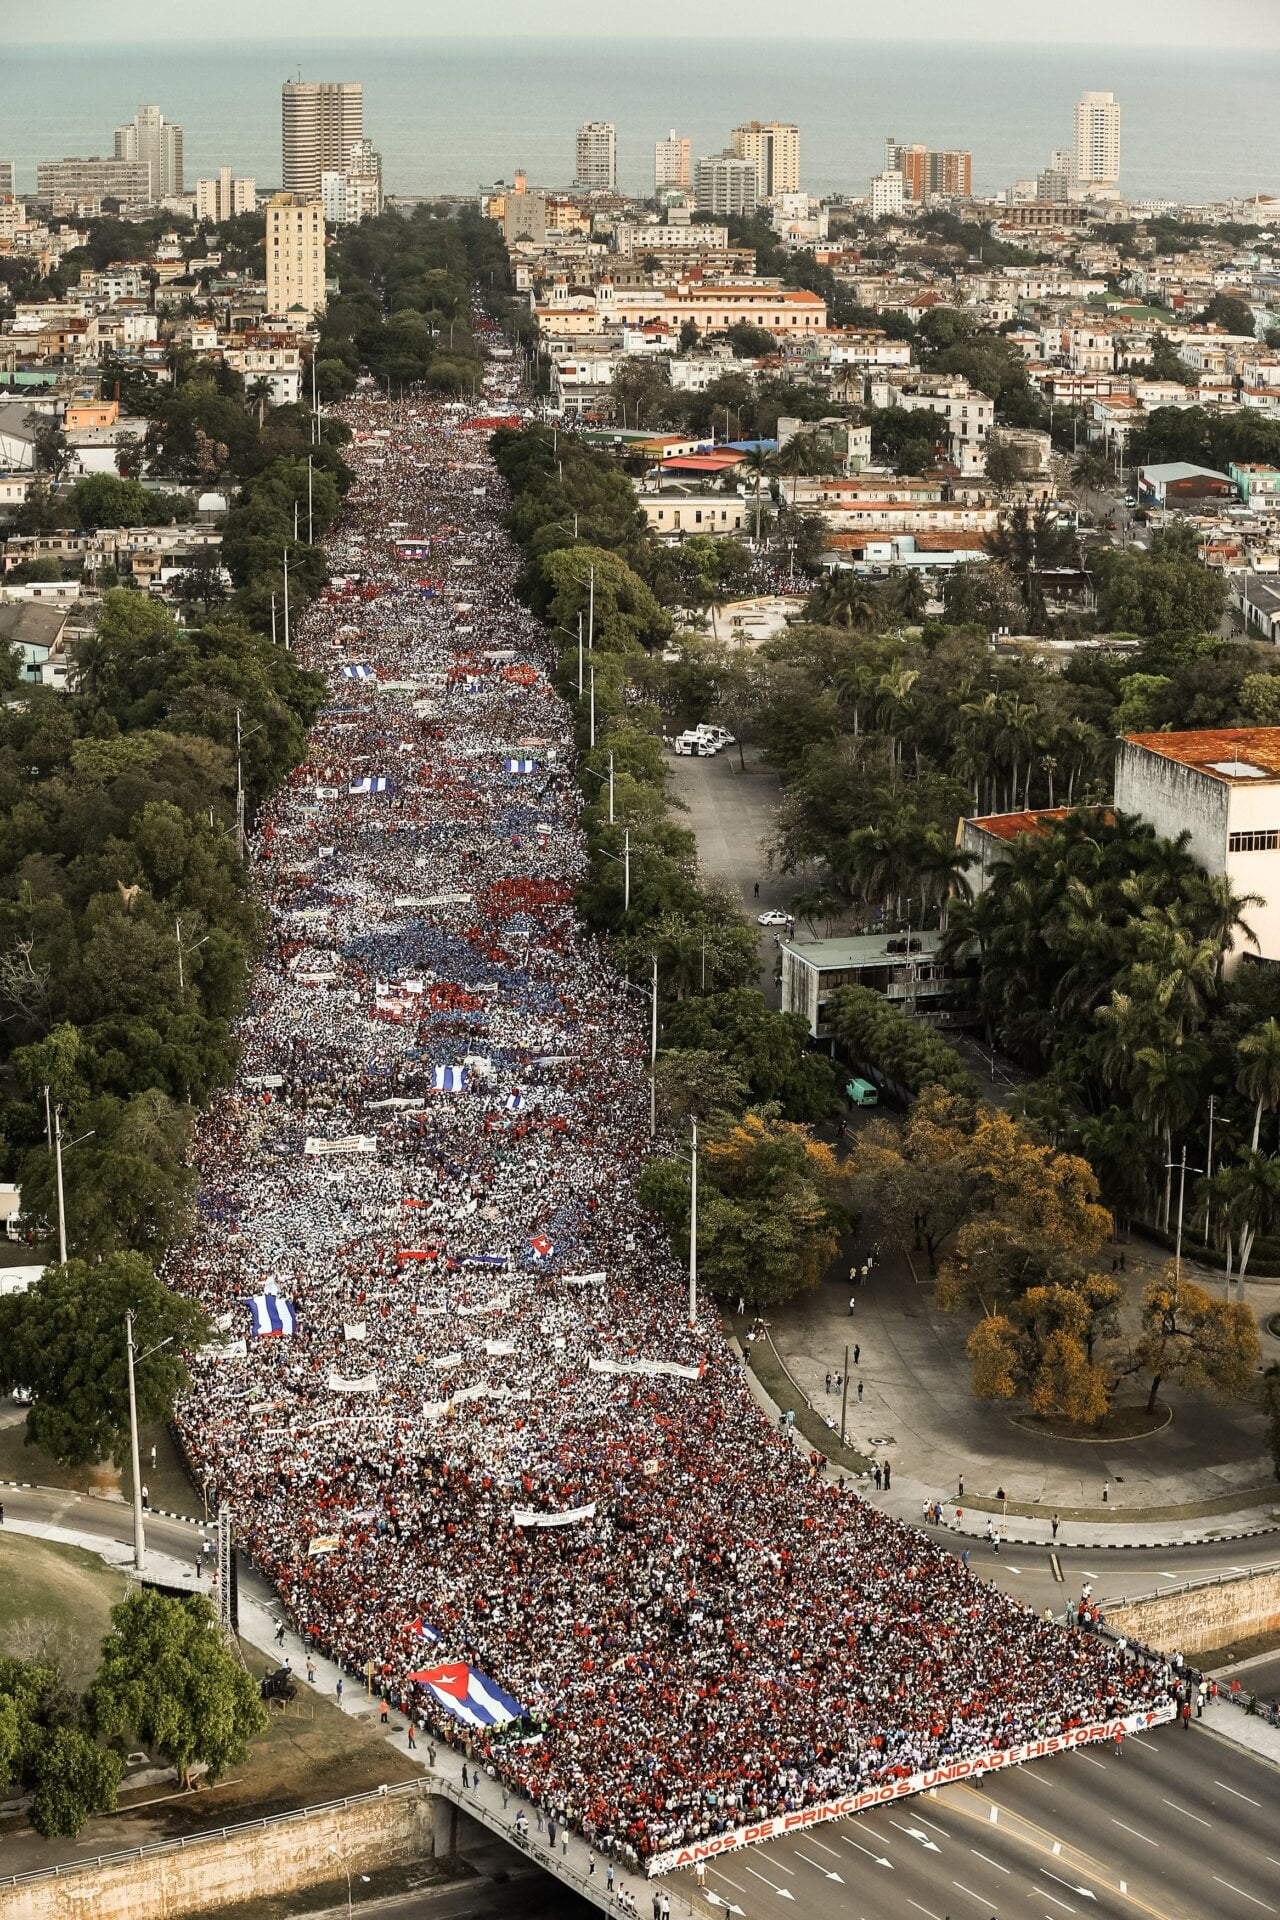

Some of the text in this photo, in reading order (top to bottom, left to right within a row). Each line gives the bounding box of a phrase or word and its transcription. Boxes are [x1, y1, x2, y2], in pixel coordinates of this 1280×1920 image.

[745, 1823, 774, 1842] DE
[923, 1753, 1005, 1786] UNIDAD
[1008, 1750, 1021, 1762] E
[1026, 1721, 1128, 1757] HISTORIA
